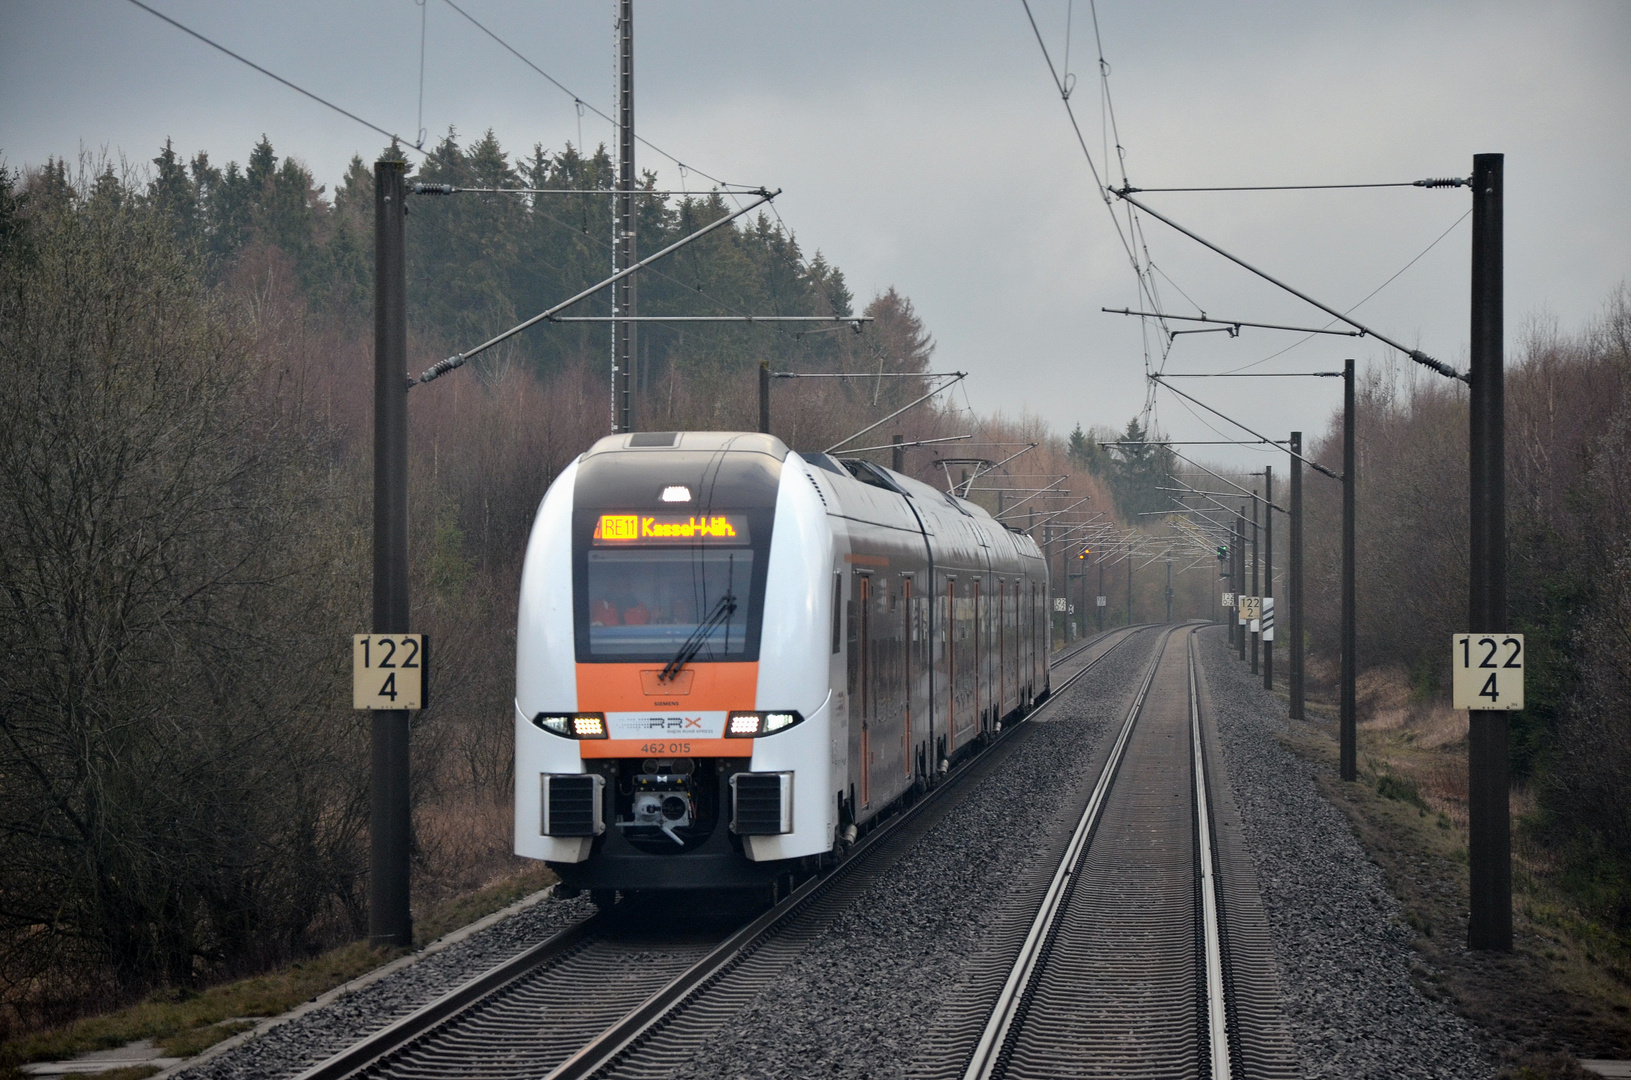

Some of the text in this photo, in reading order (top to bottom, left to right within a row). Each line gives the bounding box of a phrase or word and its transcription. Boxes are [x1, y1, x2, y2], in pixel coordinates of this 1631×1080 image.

[604, 517, 636, 537] RE11
[1241, 598, 1260, 607] 122
[1247, 608, 1253, 617] 2
[360, 638, 419, 668] 122
[1459, 638, 1521, 668] 122
[378, 672, 398, 702] 4
[1478, 672, 1500, 702] 4
[649, 717, 701, 729] RRX
[641, 743, 691, 753] 462 015
